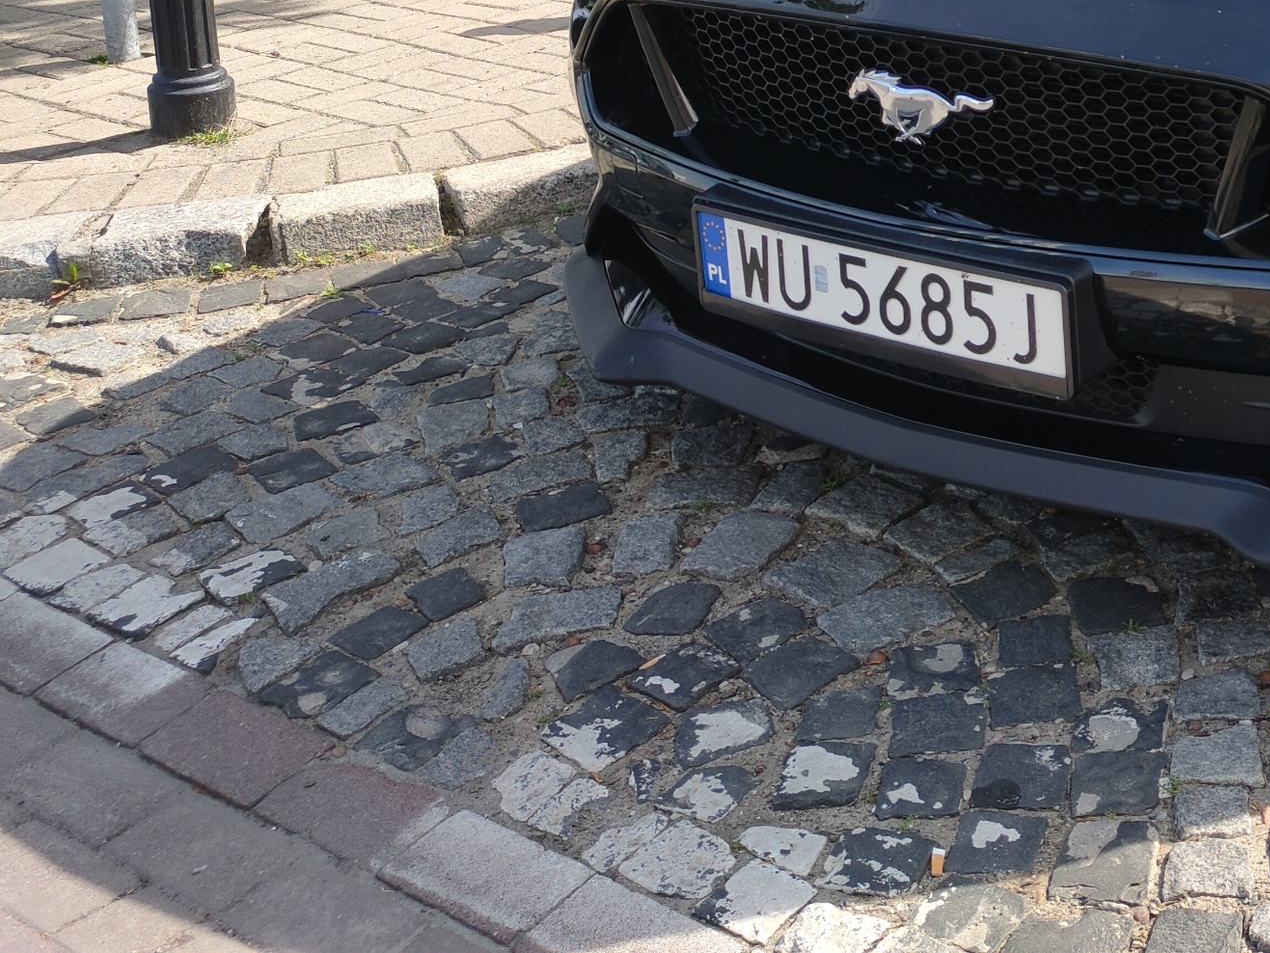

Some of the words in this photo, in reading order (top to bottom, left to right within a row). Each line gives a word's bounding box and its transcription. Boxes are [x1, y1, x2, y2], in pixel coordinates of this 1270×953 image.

[708, 263, 727, 286] PL
[738, 229, 811, 312] WU
[838, 252, 1039, 365] 5685J
